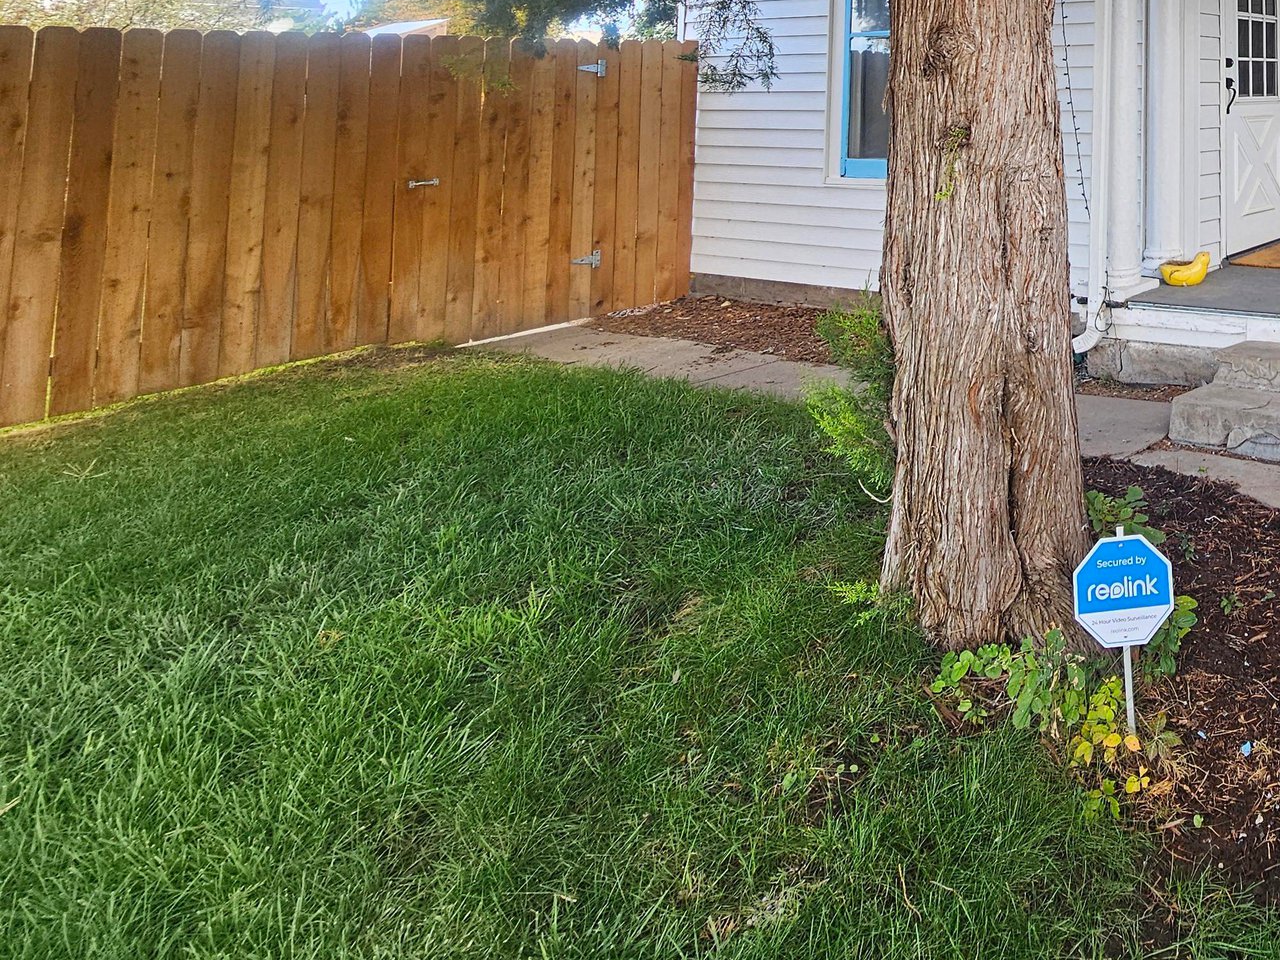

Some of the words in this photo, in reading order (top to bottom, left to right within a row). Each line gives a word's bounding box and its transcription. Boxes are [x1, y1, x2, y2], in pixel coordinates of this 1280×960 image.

[1096, 556, 1133, 569] Secured
[1135, 555, 1147, 566] by
[1087, 574, 1159, 602] reolink
[1127, 614, 1157, 622] Surveillance
[1110, 626, 1140, 634] reolink.com
